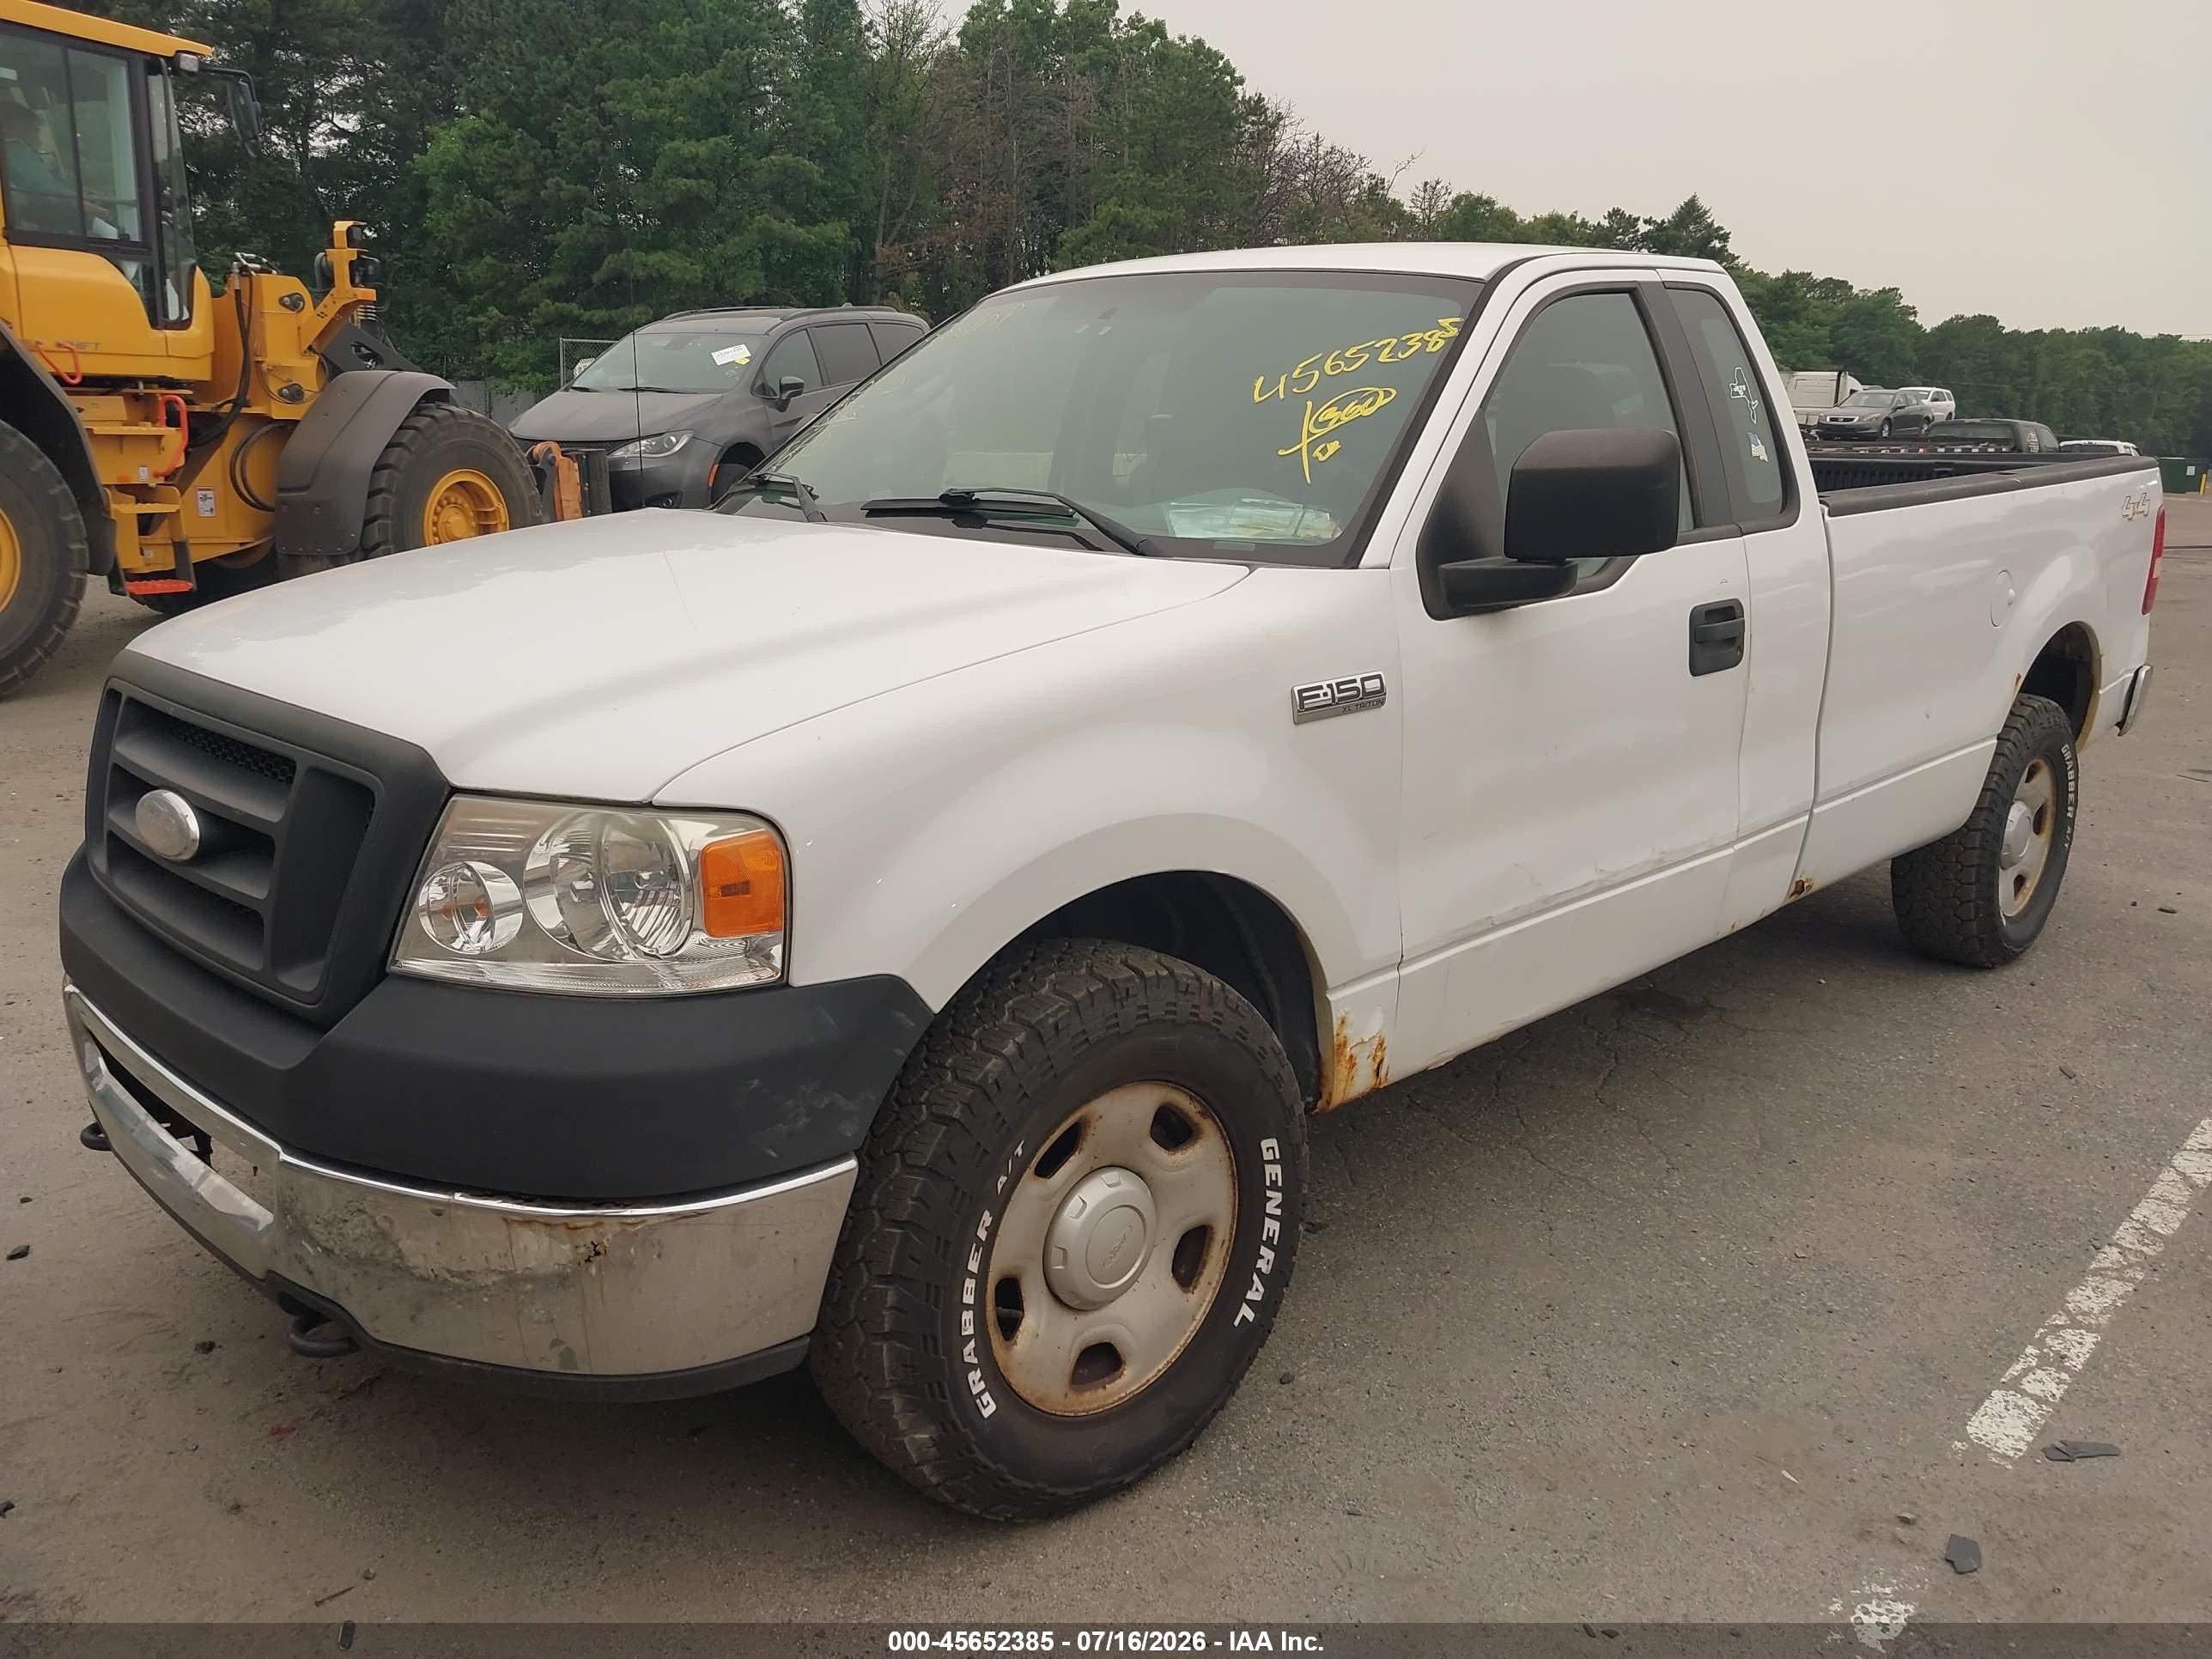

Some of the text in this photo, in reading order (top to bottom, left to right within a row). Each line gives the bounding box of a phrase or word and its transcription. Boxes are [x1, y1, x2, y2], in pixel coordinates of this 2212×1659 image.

[2122, 492, 2150, 520] 4x4
[1297, 673, 1386, 710] F-150
[1355, 699, 1385, 710] TRITON
[2061, 744, 2075, 818] GRABBER
[1233, 1138, 1283, 1328] GENERAL
[961, 1139, 1024, 1419] GRABBER A/T
